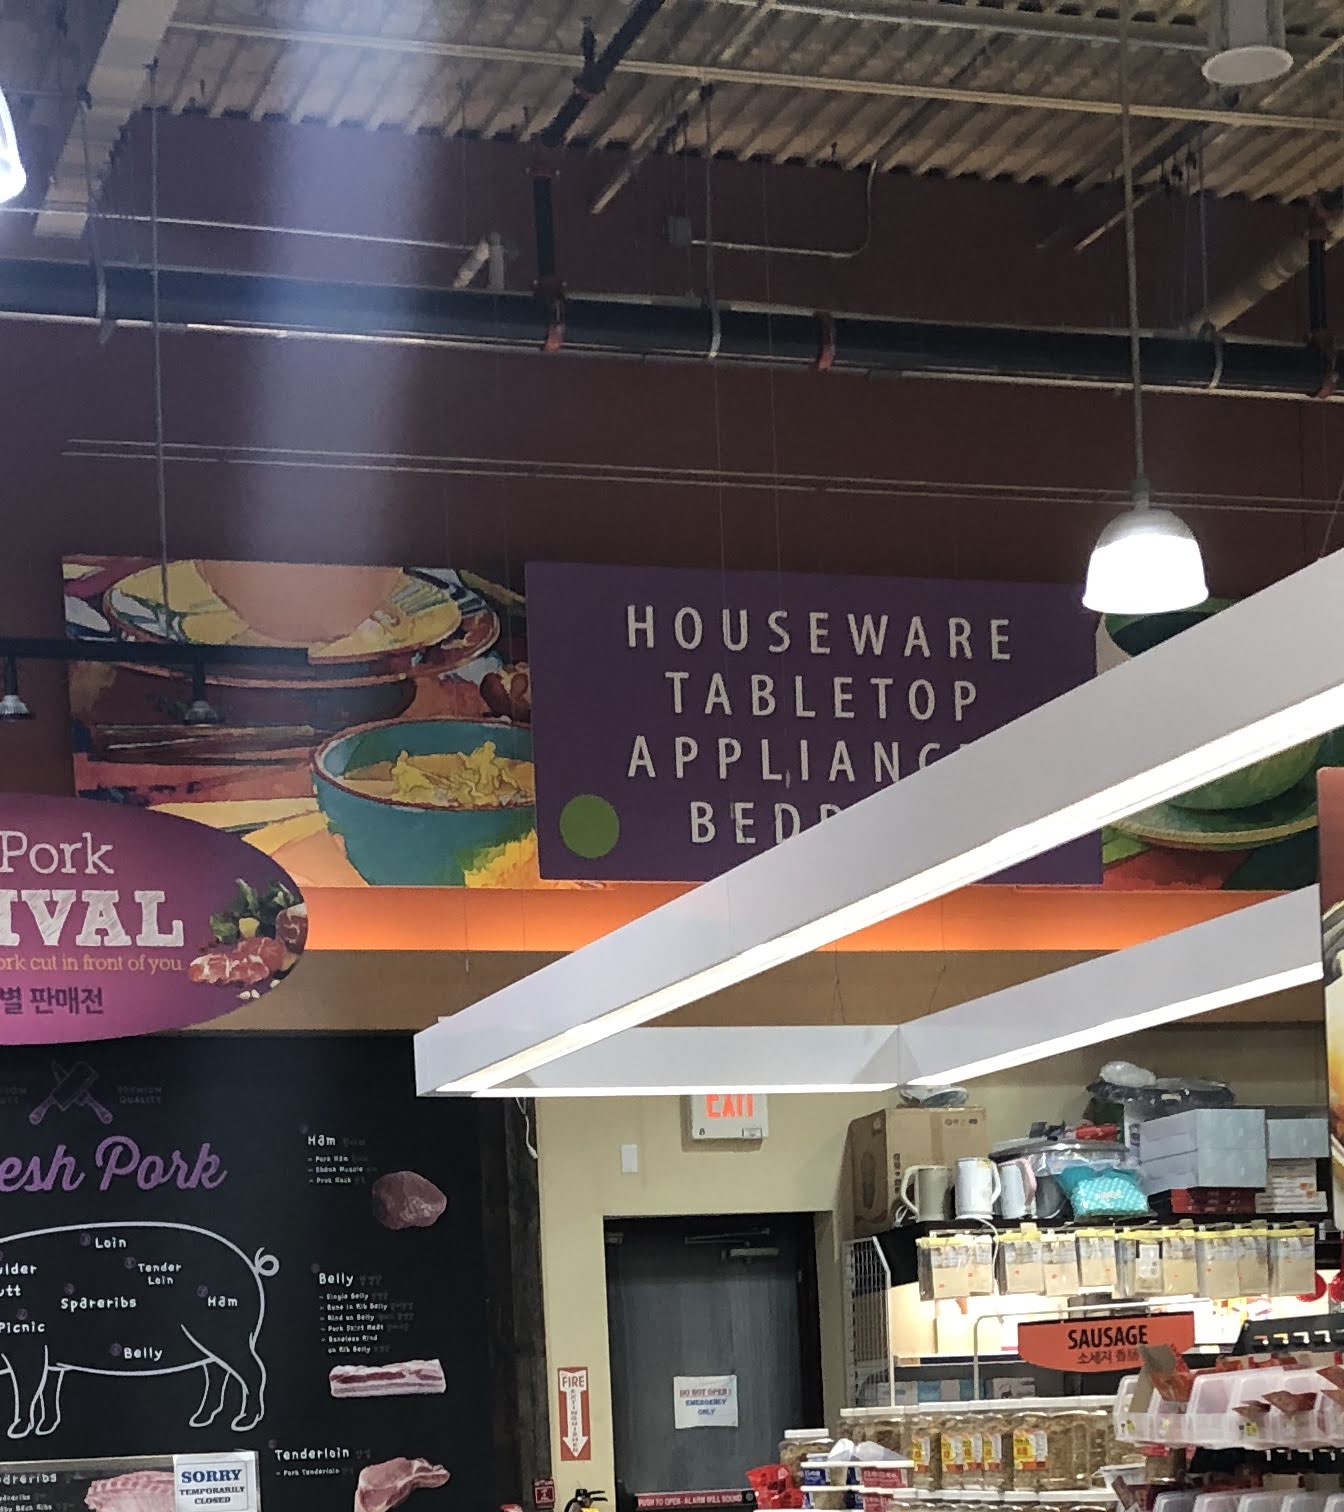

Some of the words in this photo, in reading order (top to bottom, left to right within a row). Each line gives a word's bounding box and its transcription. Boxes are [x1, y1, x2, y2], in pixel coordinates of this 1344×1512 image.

[626, 604, 1012, 661] HOUSEWARE
[664, 671, 978, 722] TABLETOP
[627, 735, 970, 783] APPLIANC
[29, 953, 57, 972] cut
[61, 953, 79, 972] in
[82, 952, 124, 972] front
[126, 952, 145, 972] of
[29, 985, 104, 1016] 판매전
[307, 1134, 336, 1147] Ham
[95, 1135, 227, 1191] Pork
[95, 1237, 127, 1249] Loin
[138, 1262, 182, 1273] Tender
[148, 1275, 173, 1286] Loin
[319, 1272, 354, 1287] Belly
[61, 1295, 137, 1312] Spareribs
[207, 1296, 238, 1308] Ham
[1068, 1325, 1149, 1349] SAUSAGE
[123, 1346, 163, 1361] Belly
[562, 1376, 584, 1387] FIRE
[679, 1389, 690, 1397] DO
[692, 1389, 705, 1397] NOT
[707, 1388, 727, 1396] OPEN
[274, 1446, 351, 1461] Tenderloin
[181, 1468, 242, 1483] SORRY
[179, 1486, 244, 1496] TEMPORARILY
[194, 1497, 231, 1505] CLOSED
[638, 1499, 654, 1507] PUSH
[656, 1498, 663, 1506] TO
[707, 1496, 720, 1504] WILL
[722, 1494, 742, 1503] SOUND
